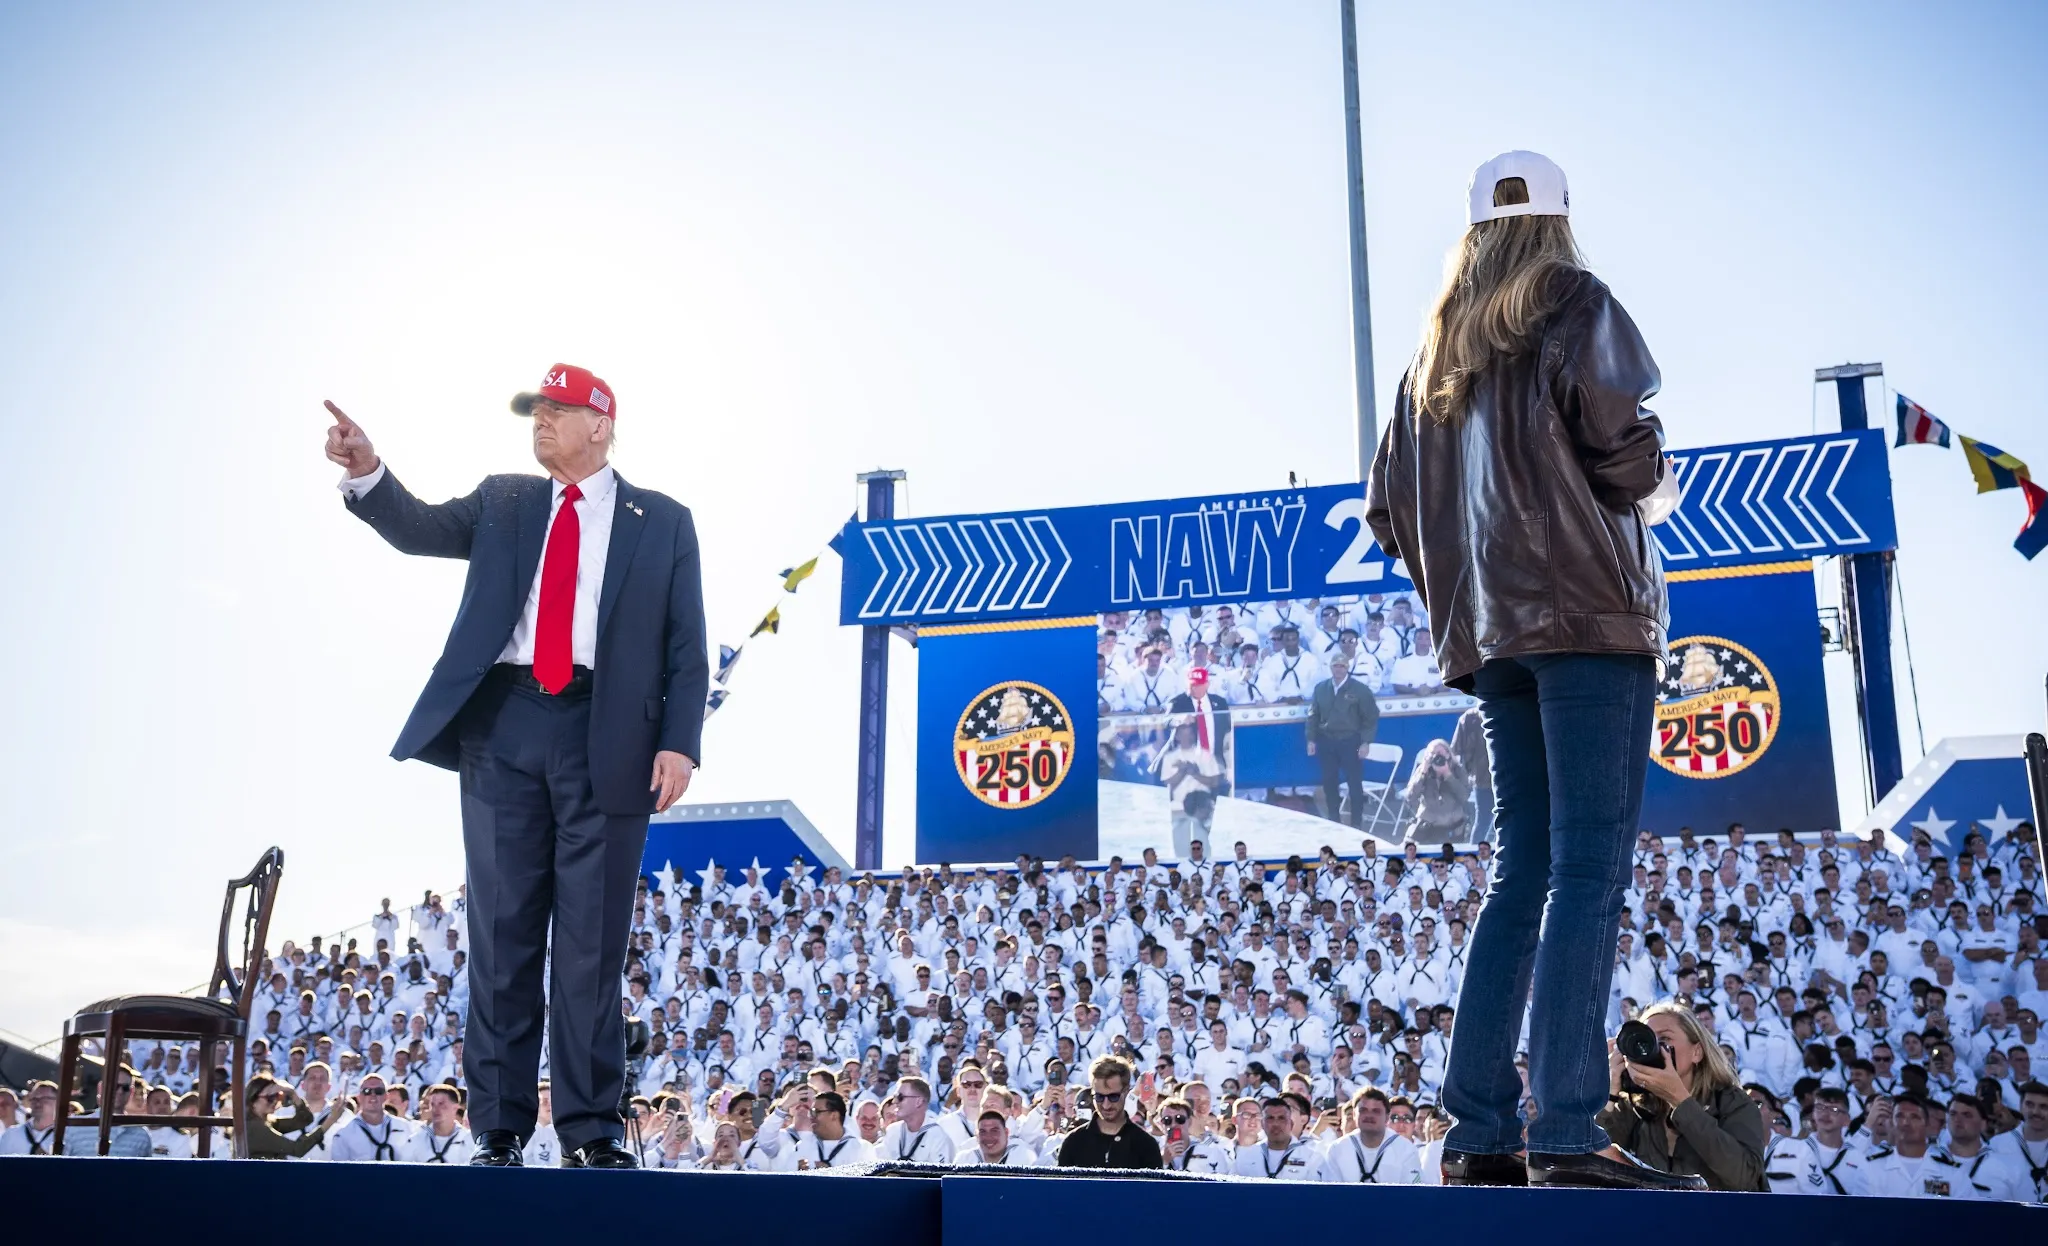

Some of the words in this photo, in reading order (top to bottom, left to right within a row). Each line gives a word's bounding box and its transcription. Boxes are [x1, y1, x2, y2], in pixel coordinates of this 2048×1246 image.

[542, 371, 568, 388] SA
[1198, 494, 1305, 512] AMERICA'S
[1110, 504, 1307, 604] NAVY
[1713, 690, 1740, 702] NAVY
[1657, 711, 1761, 758] 250
[976, 749, 1057, 790] 250
